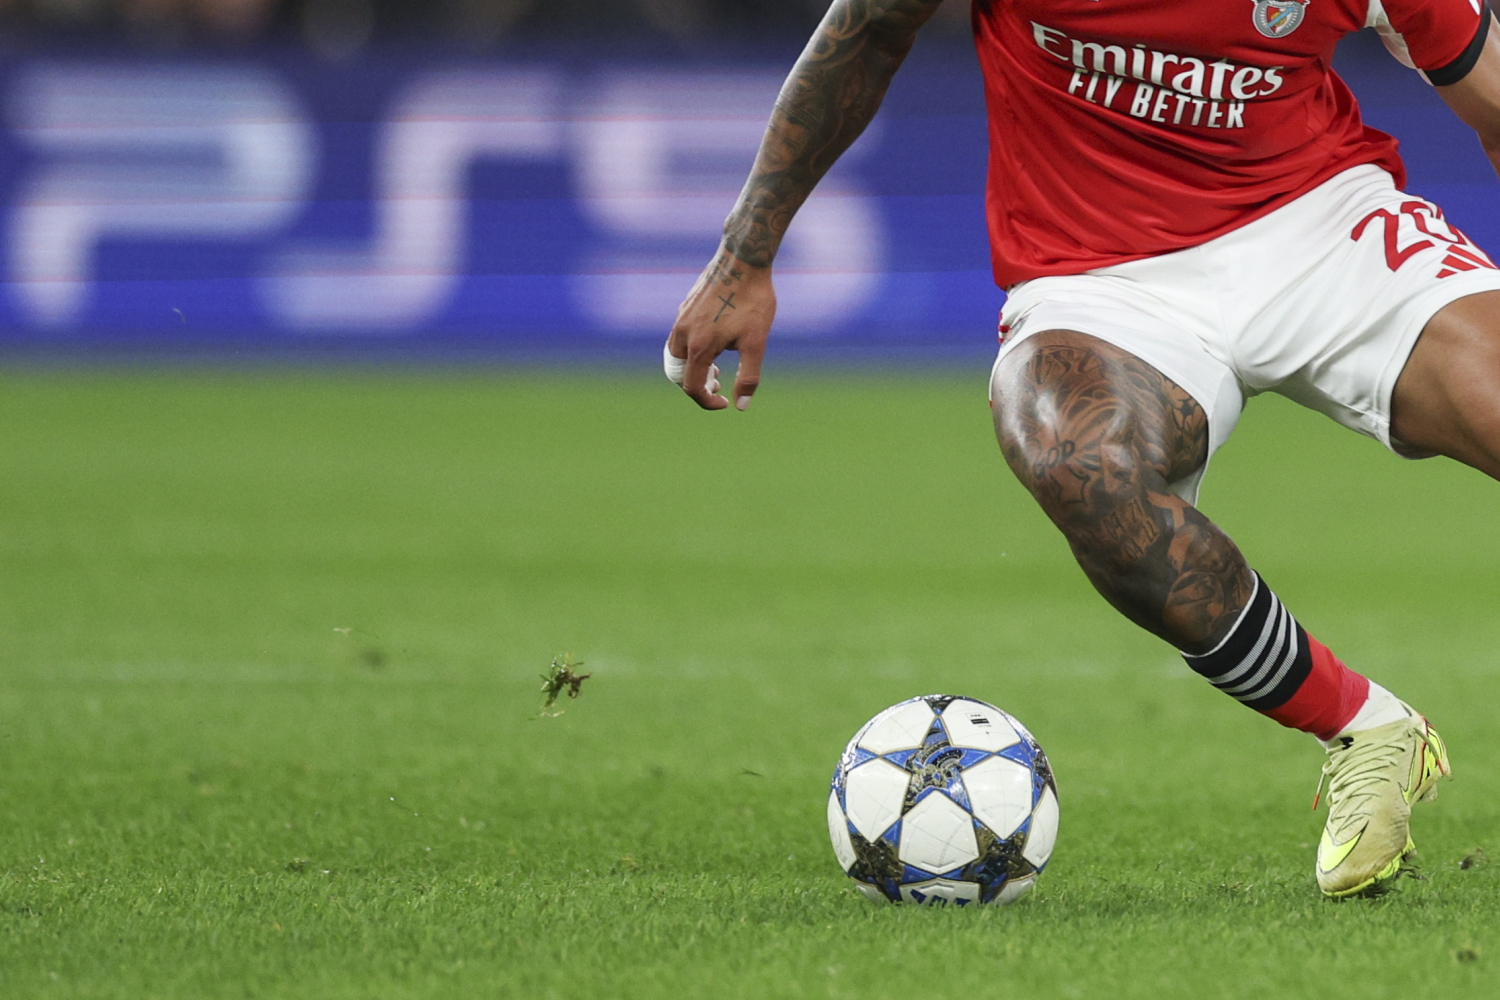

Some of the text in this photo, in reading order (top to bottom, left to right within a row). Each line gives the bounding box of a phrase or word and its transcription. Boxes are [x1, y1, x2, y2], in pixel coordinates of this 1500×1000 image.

[1030, 20, 1284, 101] Emirates
[1067, 68, 1245, 129] FLY BETTER
